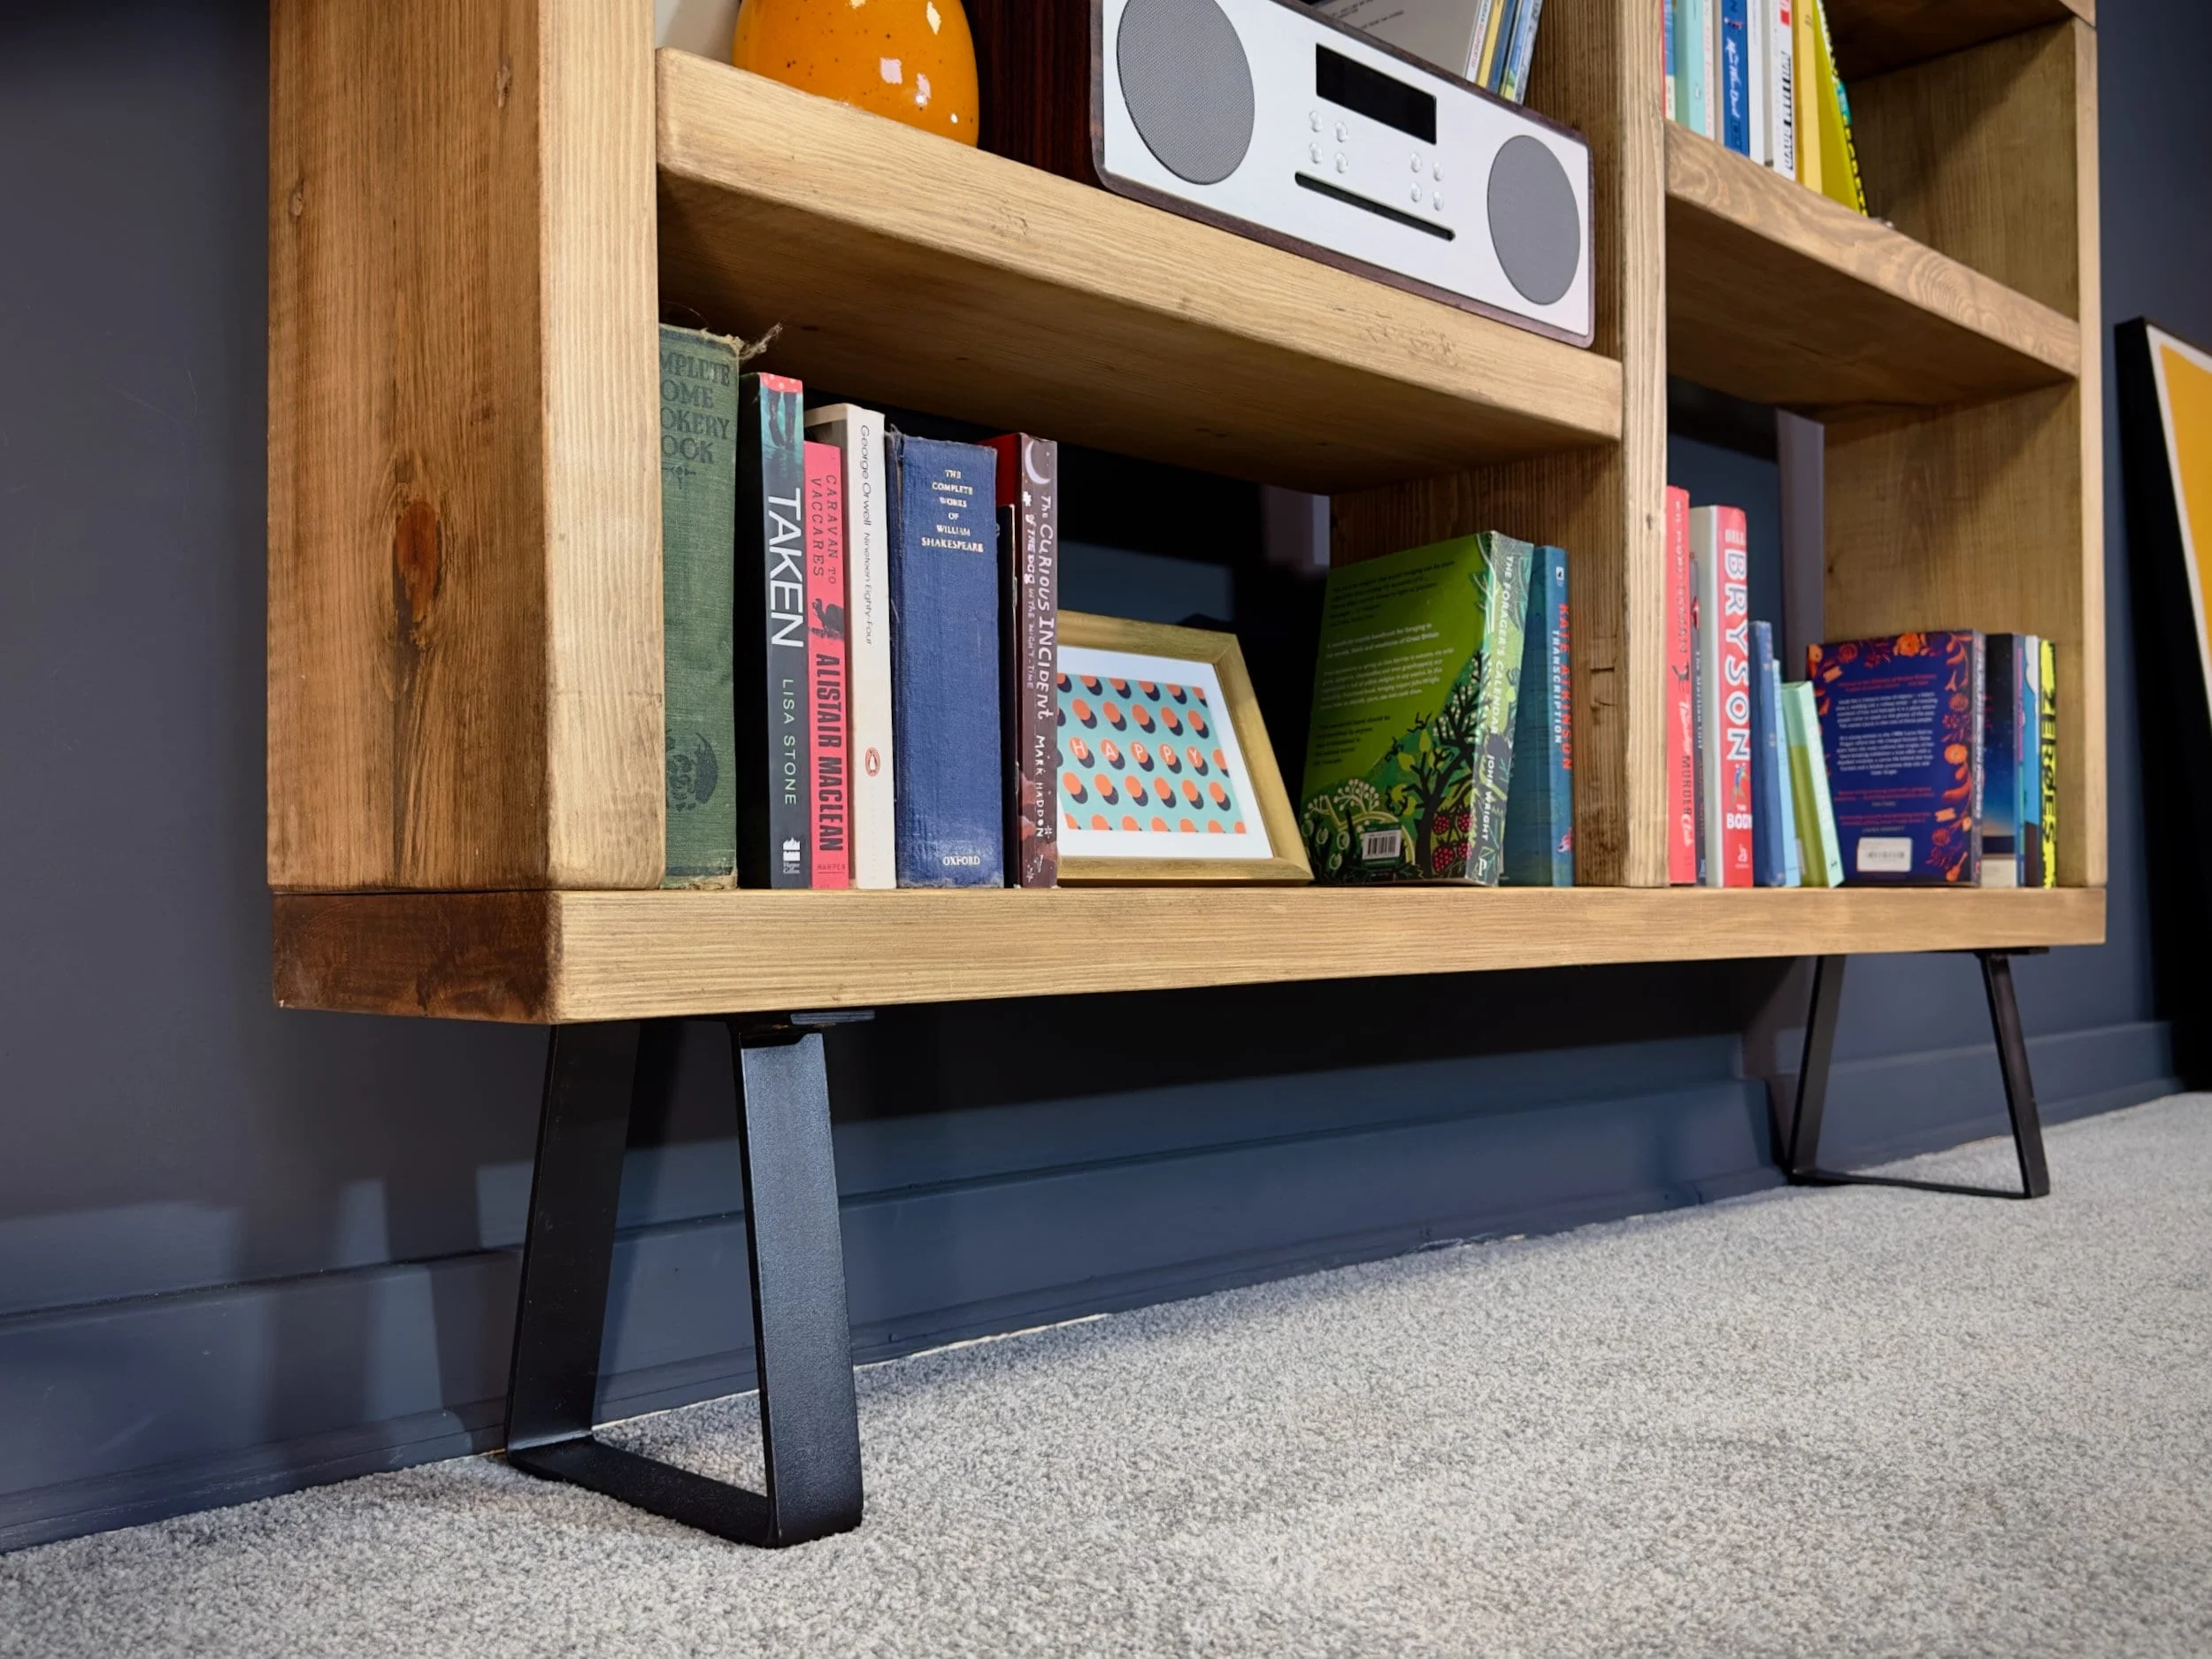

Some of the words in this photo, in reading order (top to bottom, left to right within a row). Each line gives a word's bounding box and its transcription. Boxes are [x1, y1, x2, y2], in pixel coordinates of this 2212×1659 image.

[660, 407, 730, 440] OKERY
[861, 425, 870, 479] George
[945, 469, 962, 479] THE
[863, 482, 872, 526] Orwell
[932, 481, 973, 495] COMPLETE
[939, 496, 967, 508] WORKS
[810, 478, 825, 577] VACCARES
[826, 474, 839, 558] CARAVAN
[936, 524, 971, 536] WILLIAM
[768, 488, 804, 647] TAKEN
[921, 536, 984, 553] SHAKESPEARE
[1504, 556, 1514, 577] THE
[828, 566, 836, 585] TO
[863, 584, 872, 644] Eighty-Four
[1496, 581, 1511, 657] FORAGER'S
[1558, 603, 1571, 653] KATE
[1724, 549, 1750, 761] BRYSON
[782, 679, 795, 724] LISA
[816, 654, 841, 748] ALISTAIR
[1489, 660, 1504, 735] CALENDAR
[1552, 630, 1562, 744] TRANSCRIPTION
[1560, 664, 1573, 770] ATKINSON
[783, 735, 796, 804] STONE
[1035, 734, 1046, 776] MARK
[1071, 739, 1199, 764] HAPPY
[1485, 755, 1495, 787] JOHN
[818, 757, 843, 851] MACLEAN
[1035, 782, 1045, 837] HADDON
[1681, 756, 1692, 815] MURDER
[1480, 791, 1493, 841] WRIGHT
[943, 856, 980, 865] OXFORD
